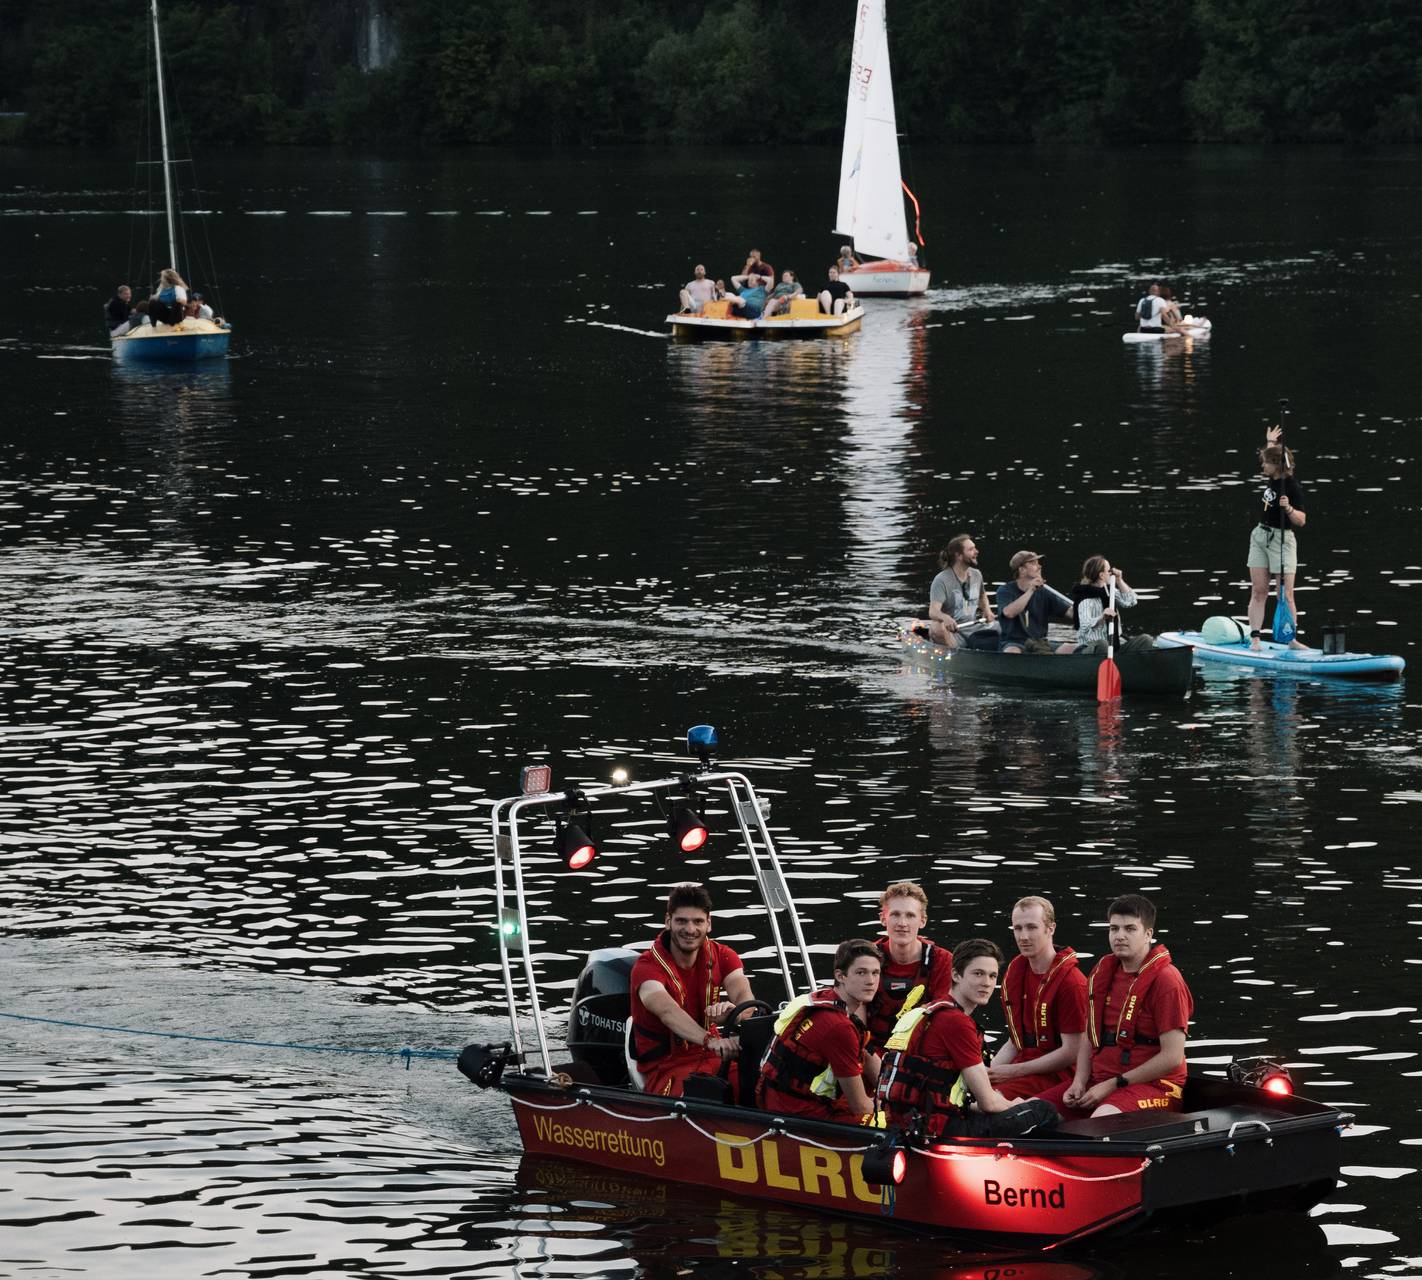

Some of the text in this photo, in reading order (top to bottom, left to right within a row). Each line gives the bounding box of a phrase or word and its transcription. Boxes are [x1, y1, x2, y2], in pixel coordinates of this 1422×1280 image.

[1138, 1098, 1169, 1109] DLRG
[533, 1114, 665, 1167] Wasserrettung
[984, 1179, 1065, 1209] Bernd
